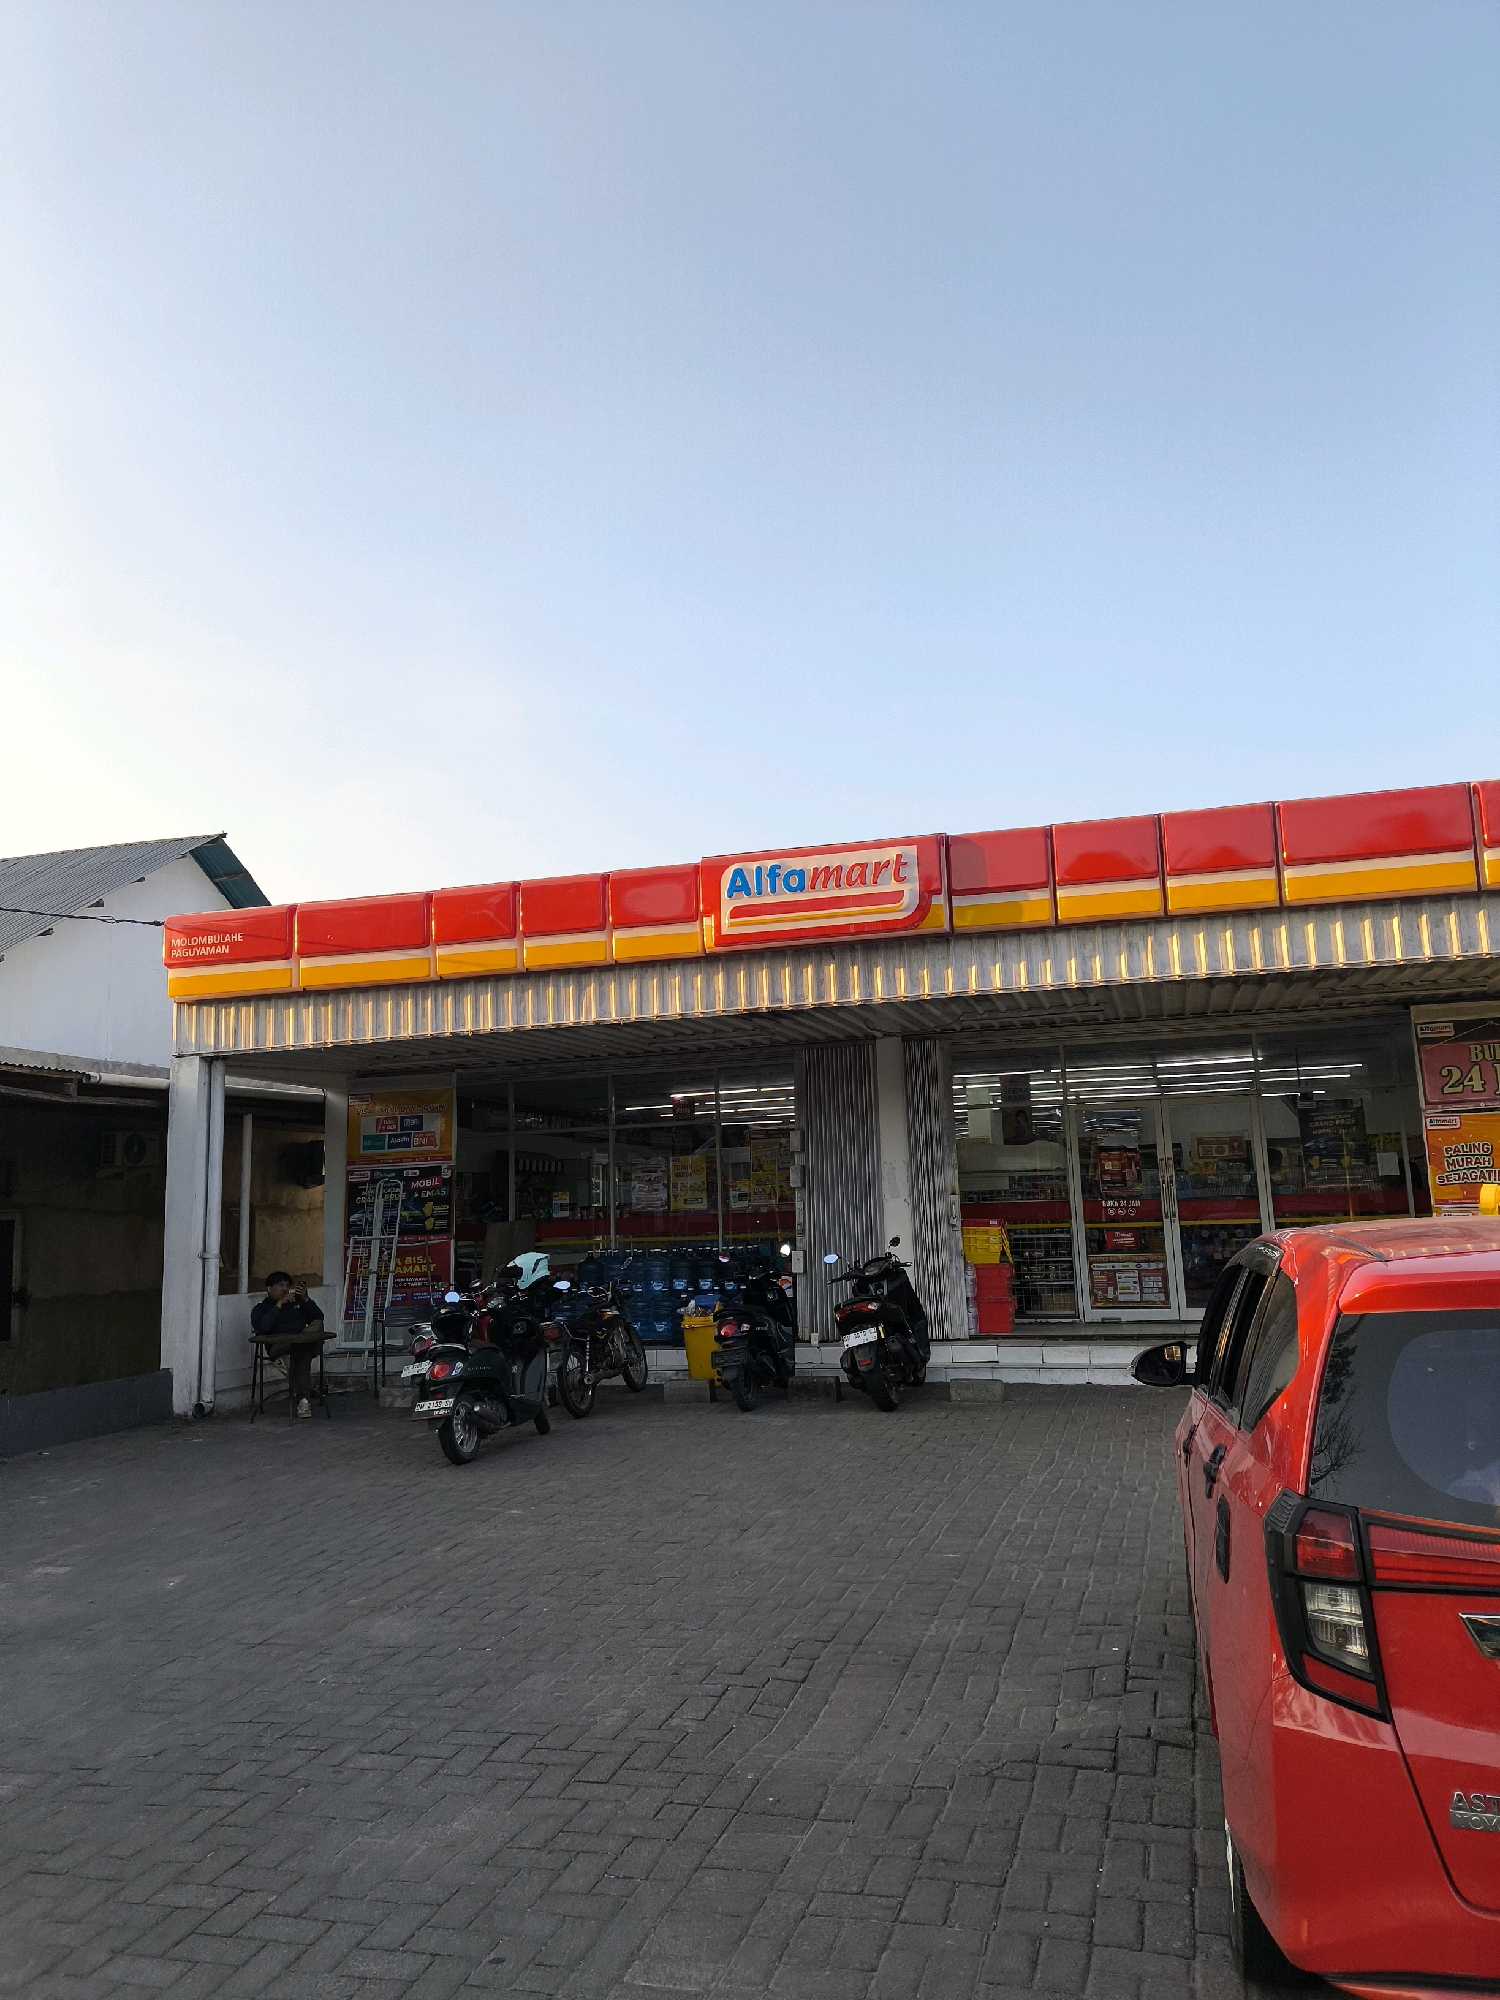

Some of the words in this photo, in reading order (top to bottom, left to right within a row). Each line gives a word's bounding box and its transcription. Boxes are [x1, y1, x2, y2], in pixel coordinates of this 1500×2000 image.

[726, 853, 909, 899] Alfamart
[171, 932, 244, 948] MOLOMBULAHE
[171, 944, 230, 958] PAGUYAMAN
[1440, 1065, 1485, 1094] 24
[1309, 1120, 1335, 1128] GRAND
[413, 1137, 428, 1146] BNI
[1444, 1142, 1491, 1155] PALING
[1445, 1156, 1491, 1170] MURAH
[411, 1178, 440, 1189] MOBIL
[421, 1187, 446, 1198] EMAS
[1102, 1200, 1118, 1208] BUKA
[404, 1255, 432, 1265] BISA
[1454, 1812, 1500, 1832] TOY
